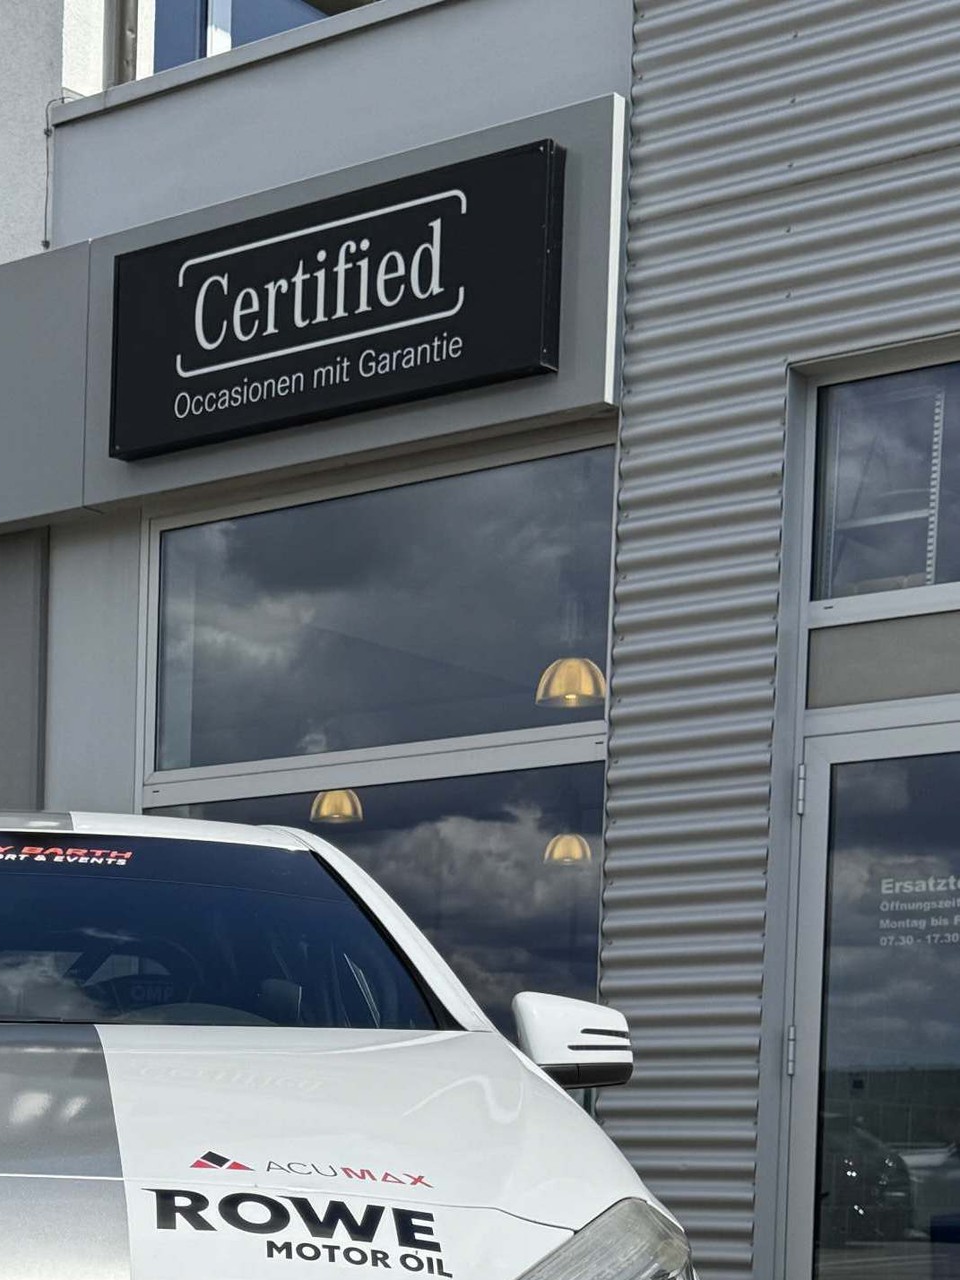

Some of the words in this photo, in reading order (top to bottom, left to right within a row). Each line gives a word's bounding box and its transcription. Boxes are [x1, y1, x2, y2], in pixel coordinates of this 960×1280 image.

[194, 217, 444, 351] Certified
[173, 370, 304, 419] Occasionen
[313, 356, 350, 388] mit
[358, 331, 463, 379] Garantie
[21, 846, 133, 859] BARTH
[53, 856, 127, 866] EVENTS
[878, 918, 927, 930] Montag
[930, 915, 949, 926] bis
[879, 934, 914, 947] 07.30
[925, 932, 960, 944] 17.30
[265, 1160, 434, 1188] ACUMAX
[141, 1187, 442, 1252] ROWE
[266, 1240, 392, 1269] MOTOR
[399, 1253, 453, 1278] OIL
